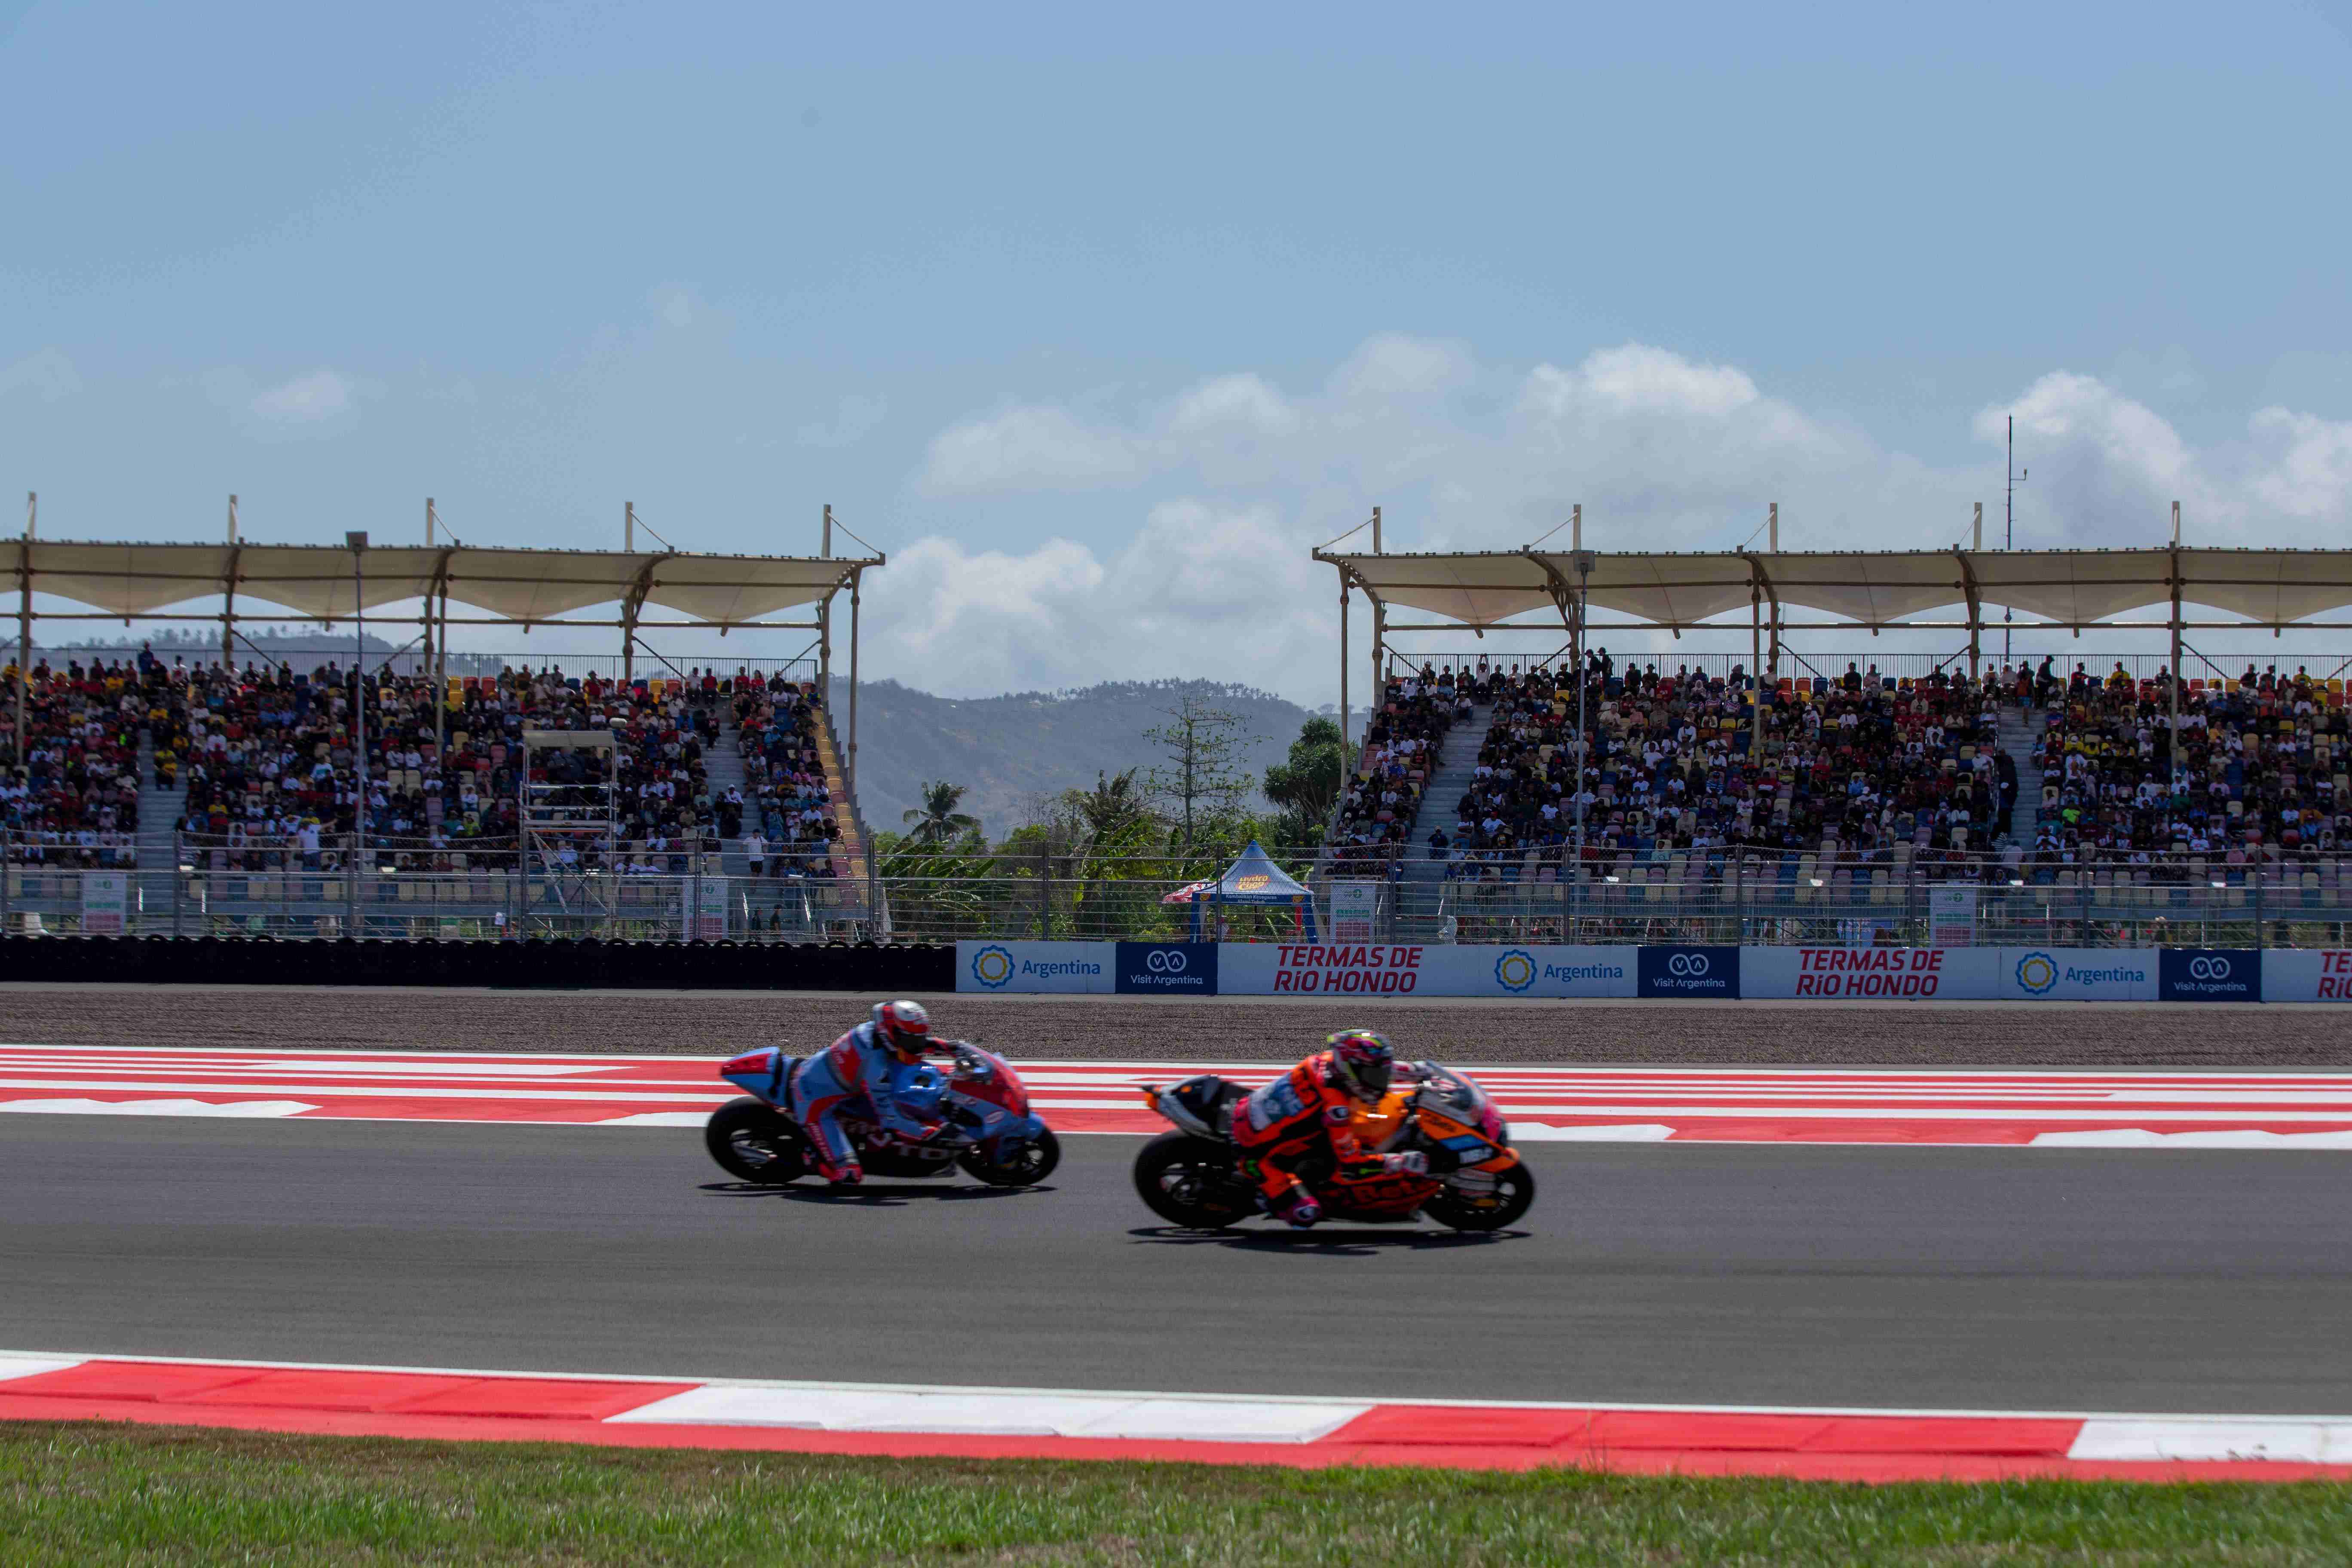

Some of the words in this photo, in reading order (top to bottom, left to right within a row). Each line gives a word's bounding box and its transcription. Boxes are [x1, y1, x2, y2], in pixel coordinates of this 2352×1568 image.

[1278, 946, 1384, 968] TERMAS
[1389, 947, 1423, 968] DE
[1799, 949, 1906, 971] TERMAS
[1911, 950, 1944, 971] DE
[1021, 960, 1101, 978] Argentina
[1544, 963, 1623, 982] Argentina
[2065, 967, 2144, 985] Argentina
[1130, 975, 1152, 984] Visit
[1153, 975, 1203, 986] Argentina
[1324, 971, 1417, 992] HONDO
[1653, 978, 1674, 987] Visit
[1675, 979, 1726, 989] Argentina
[1845, 974, 1938, 996] HONDO
[2173, 982, 2195, 991] Visit
[2196, 982, 2247, 992] Argentina
